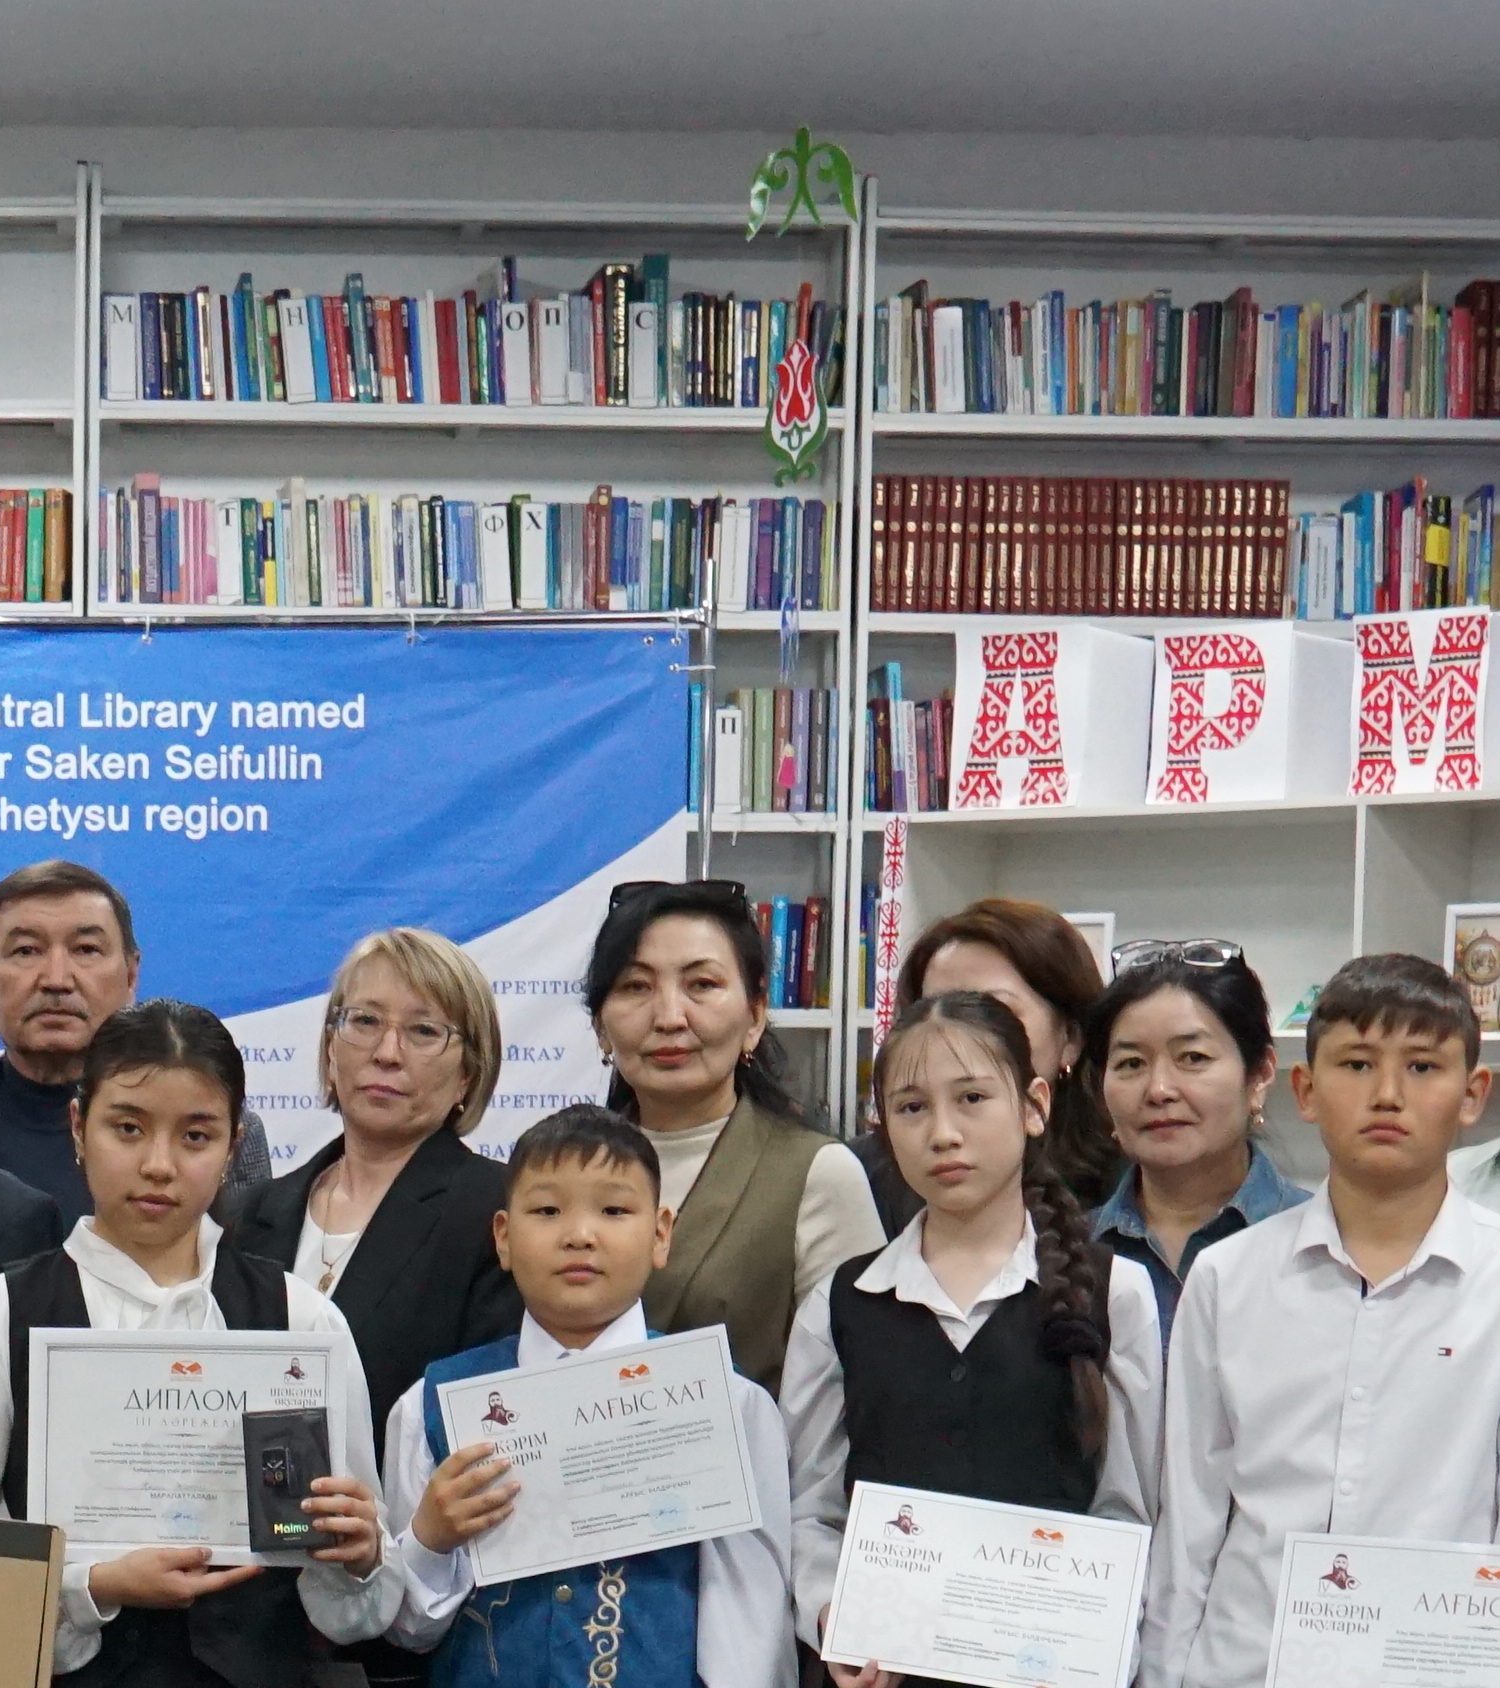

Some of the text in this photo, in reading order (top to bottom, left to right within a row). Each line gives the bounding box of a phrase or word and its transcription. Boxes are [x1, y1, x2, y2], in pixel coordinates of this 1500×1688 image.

[80, 692, 218, 737] Library
[231, 693, 366, 729] named
[25, 744, 150, 781] Saken
[165, 744, 322, 781] Seifullin
[144, 797, 269, 840] region
[501, 1044, 566, 1064] ЙҚАУ
[487, 1094, 597, 1109] MPETITION
[123, 1388, 248, 1412] ДИПЛОМ
[663, 1379, 708, 1408] ХАТ
[494, 1431, 549, 1455] КӘРІМ
[1068, 1557, 1116, 1581] ХАТ
